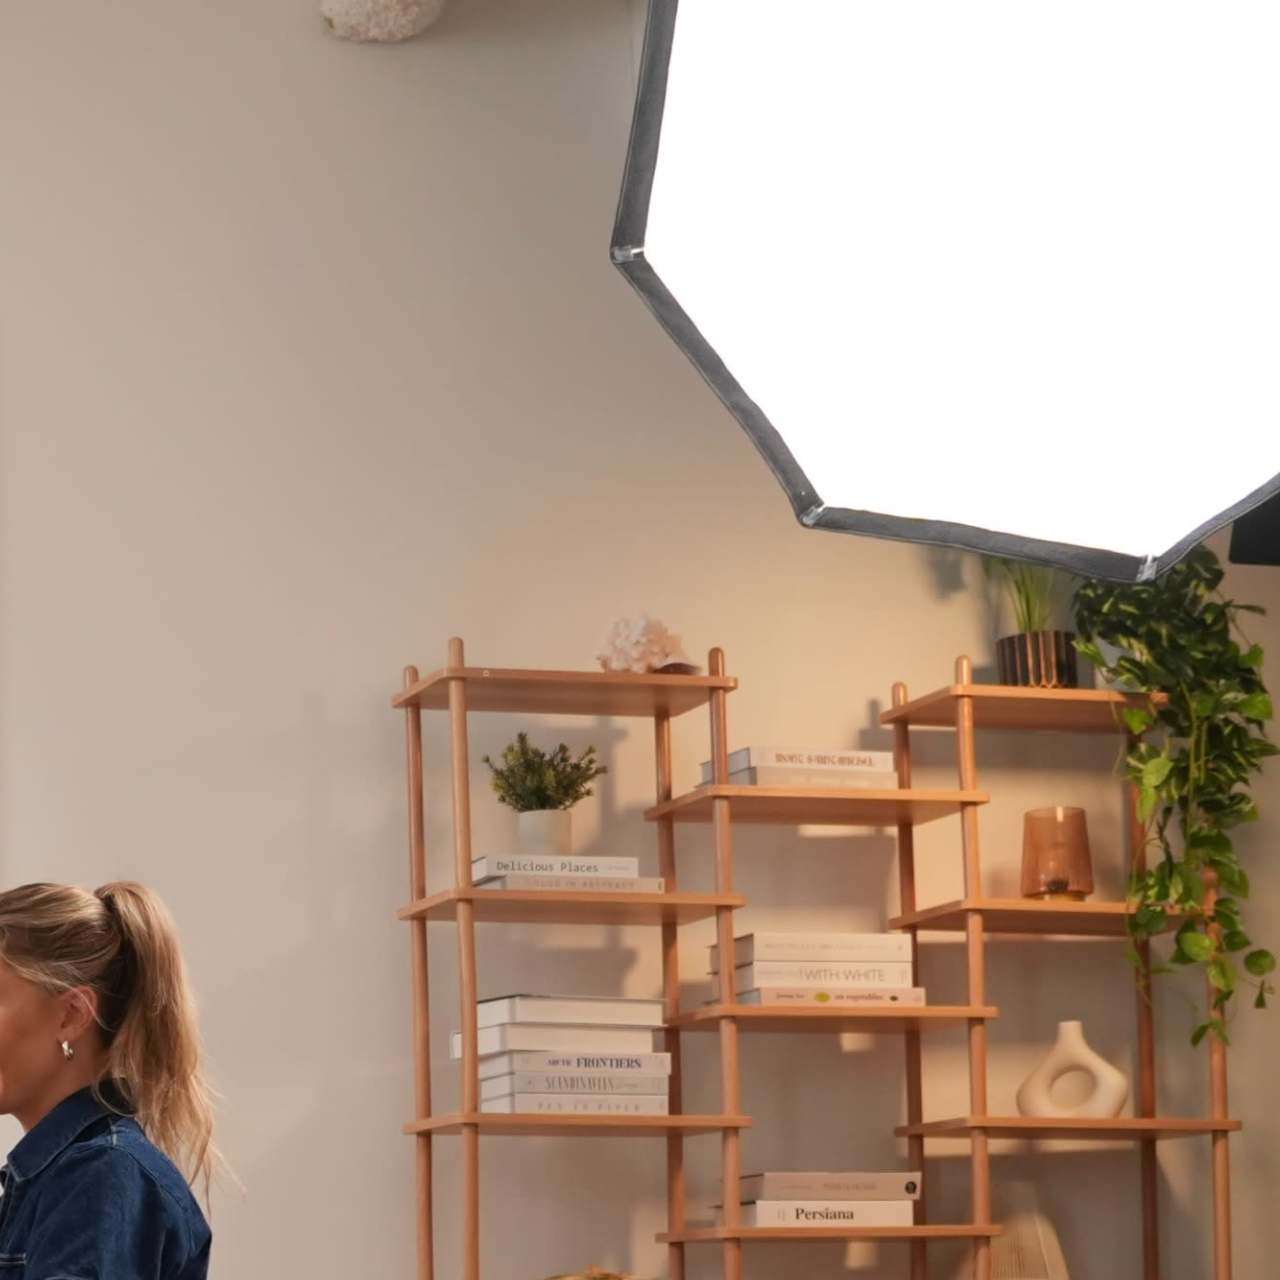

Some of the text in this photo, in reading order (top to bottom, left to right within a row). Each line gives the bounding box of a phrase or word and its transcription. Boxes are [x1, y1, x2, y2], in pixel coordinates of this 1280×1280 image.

[496, 860, 554, 872] Delicious
[560, 862, 599, 873] Places
[576, 1057, 642, 1069] FRONTIERS
[795, 1207, 854, 1221] Persiana
